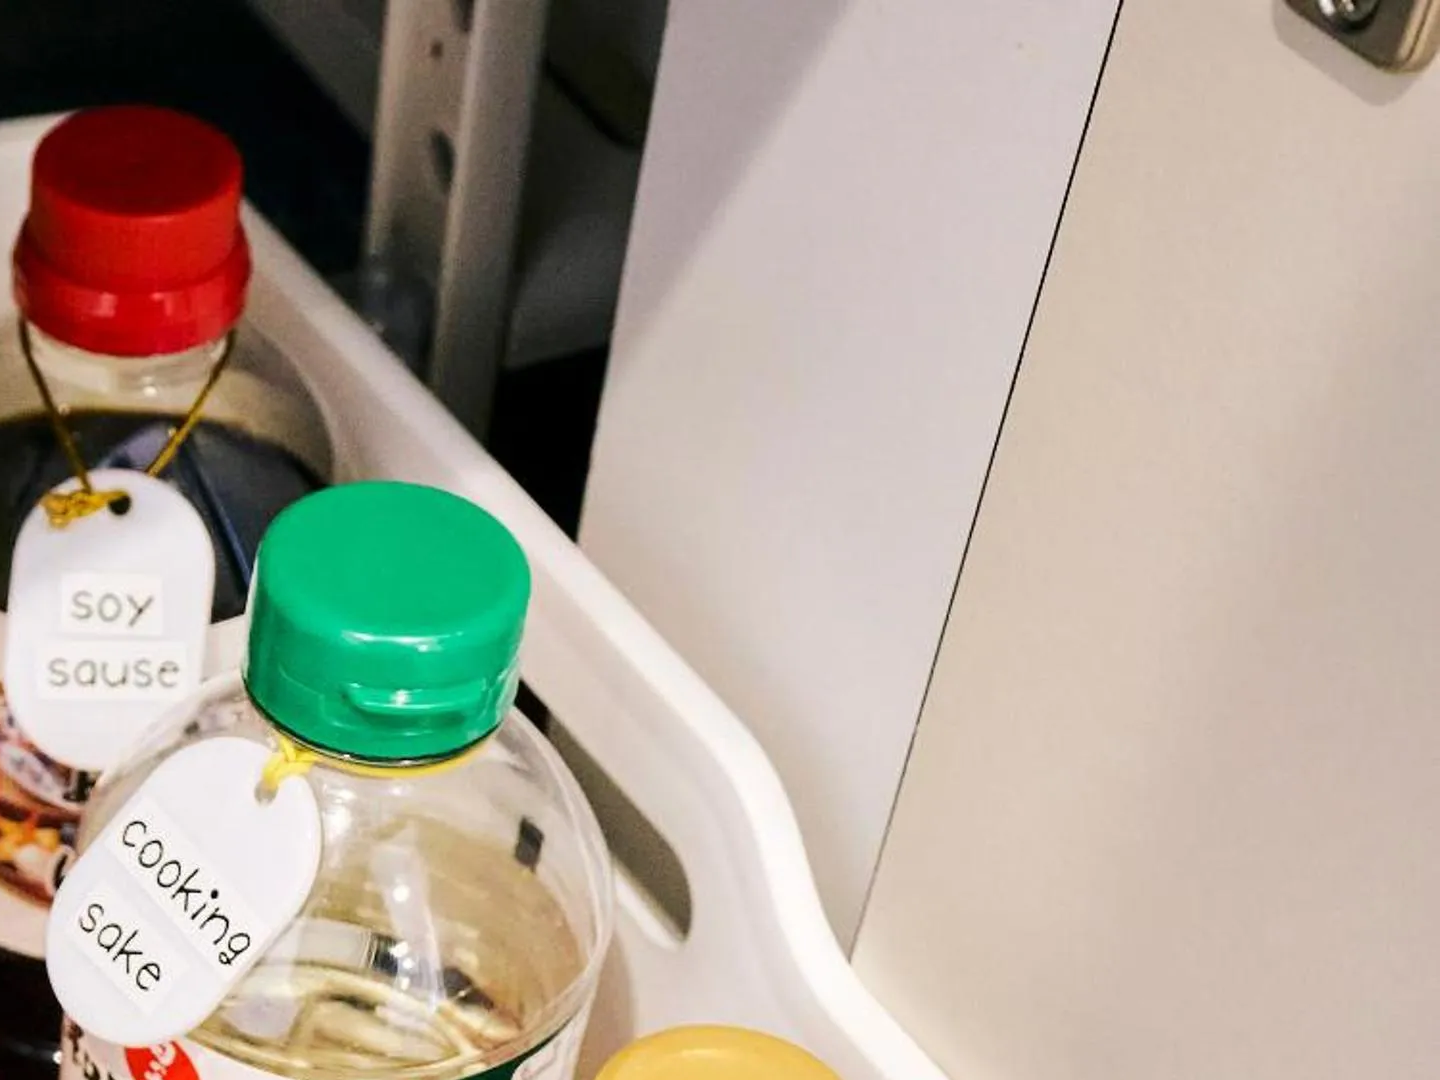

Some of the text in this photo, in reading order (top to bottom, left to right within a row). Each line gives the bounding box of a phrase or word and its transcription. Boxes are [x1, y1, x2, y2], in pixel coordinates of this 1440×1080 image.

[71, 590, 154, 628] soy
[49, 654, 182, 689] sause
[122, 820, 251, 965] cooking
[78, 903, 162, 992] sake
